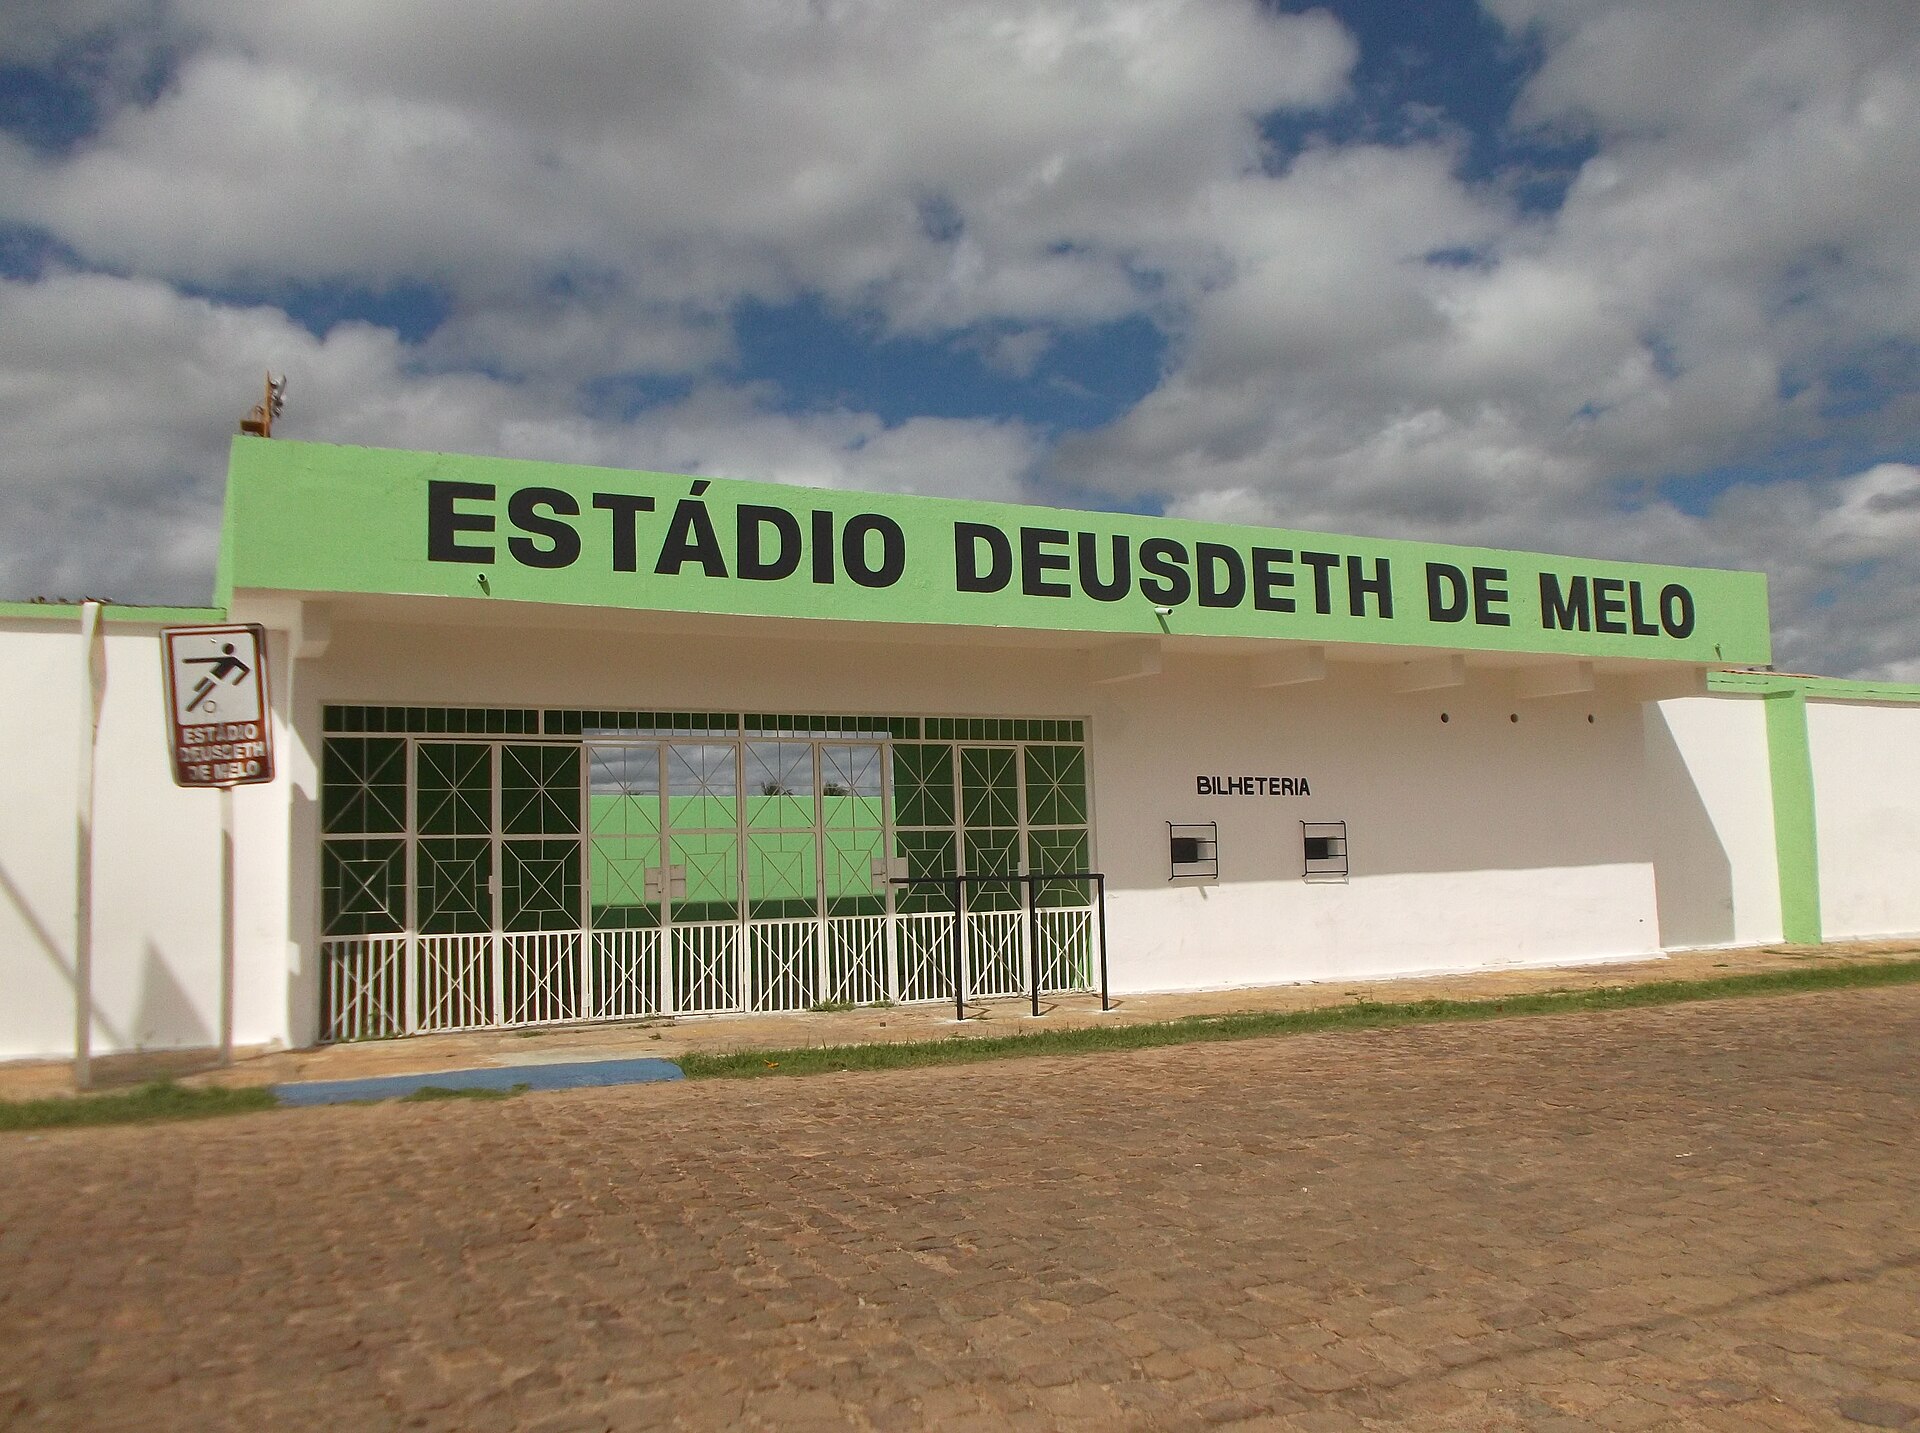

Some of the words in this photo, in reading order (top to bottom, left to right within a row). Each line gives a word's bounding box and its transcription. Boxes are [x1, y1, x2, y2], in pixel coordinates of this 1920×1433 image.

[428, 480, 906, 589] ESTÁDIO
[953, 522, 1393, 620] DEUSDETH
[1426, 563, 1511, 627] DE
[1539, 573, 1695, 640] MELO
[1197, 776, 1311, 796] BILHETERIA
